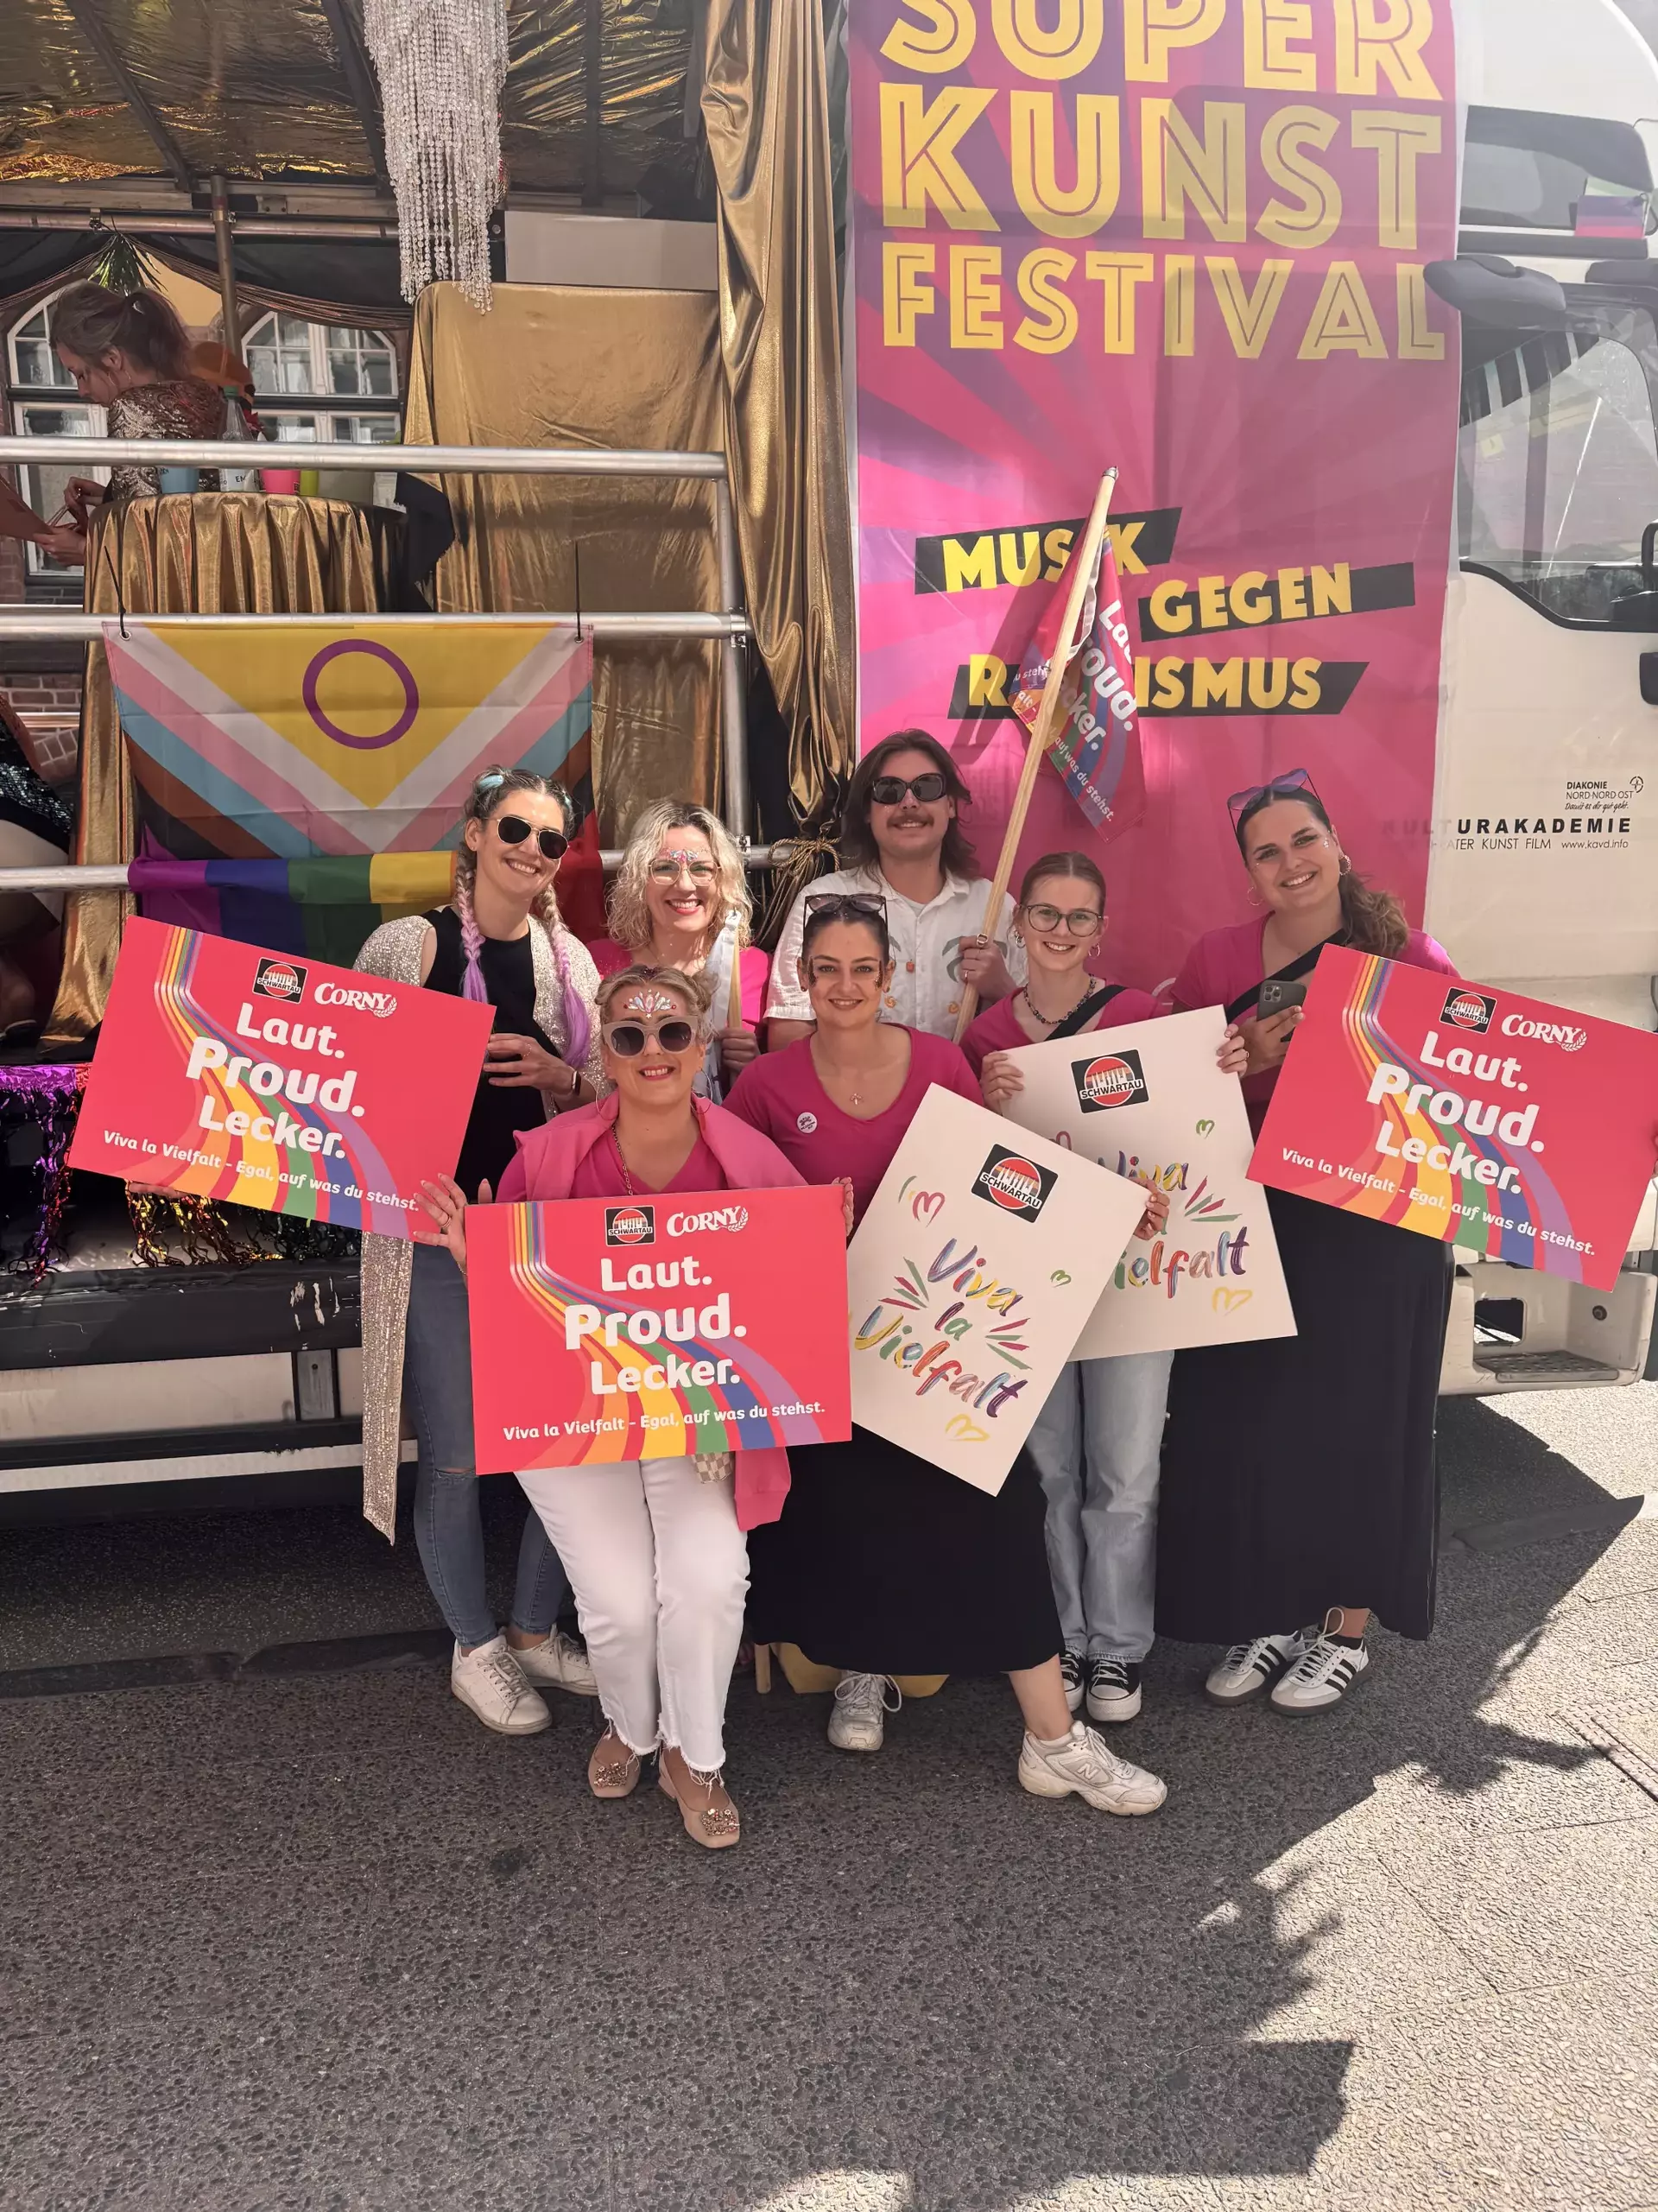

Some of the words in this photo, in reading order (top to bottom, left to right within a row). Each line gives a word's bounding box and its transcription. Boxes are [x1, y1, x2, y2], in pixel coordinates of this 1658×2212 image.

[879, 82, 1441, 250] KUNST
[882, 241, 1445, 360] FESTIVAL
[942, 522, 1149, 593] MUSK
[1149, 562, 1352, 633] GEGEN
[970, 654, 1322, 710] RISMUS
[1064, 753, 1079, 773] was
[1077, 771, 1089, 787] du
[1085, 785, 1114, 822] stehst.
[1482, 839, 1518, 850] KUNST
[1525, 838, 1551, 849] FILM
[1561, 839, 1629, 849] www.kavd.info
[258, 979, 300, 993] SCHWARTAU
[314, 983, 391, 1011] CORNY
[1446, 1007, 1487, 1024] SCHWARTAU
[236, 1002, 345, 1059] Laut.
[1502, 1014, 1580, 1043] CORNY
[186, 1036, 365, 1117] Proud.
[1081, 1080, 1142, 1099] SCHWARTAU
[1420, 1030, 1528, 1092] Laut.
[198, 1095, 345, 1159] Lecker.
[1366, 1062, 1545, 1153] Proud.
[104, 1131, 137, 1150] Viva
[142, 1138, 157, 1154] la
[162, 1144, 222, 1169] Vielfalt
[236, 1161, 275, 1182] Egal,
[279, 1171, 307, 1189] auf
[309, 1178, 339, 1194] was
[344, 1182, 364, 1200] du
[366, 1189, 420, 1213] stehst.
[1375, 1120, 1522, 1194] Lecker.
[981, 1174, 1040, 1207] SCHWARTAU
[1281, 1148, 1314, 1169] Viva
[1318, 1157, 1333, 1175] la
[1338, 1164, 1395, 1195] Vielfalt
[1408, 1188, 1446, 1211] Egal,
[1452, 1201, 1479, 1222] auf
[1482, 1212, 1514, 1231] was
[1517, 1220, 1537, 1237] du
[1540, 1227, 1595, 1256] stehst.
[667, 1206, 741, 1237] CORNY
[600, 1256, 712, 1292] Laut.
[927, 1238, 1023, 1317] Viva
[1114, 1226, 1250, 1298] ielfalt
[565, 1293, 747, 1350] Proud.
[934, 1301, 972, 1341] la
[590, 1354, 740, 1395] Lecker.
[854, 1305, 1028, 1418] Vielfalt
[503, 1427, 540, 1441] Viva
[544, 1423, 560, 1436] la
[564, 1417, 624, 1436] Vielfalt
[641, 1414, 679, 1430] Egal,
[684, 1410, 710, 1427] auf
[714, 1409, 744, 1422] was
[750, 1404, 768, 1419] du
[771, 1401, 826, 1417] stehst.
